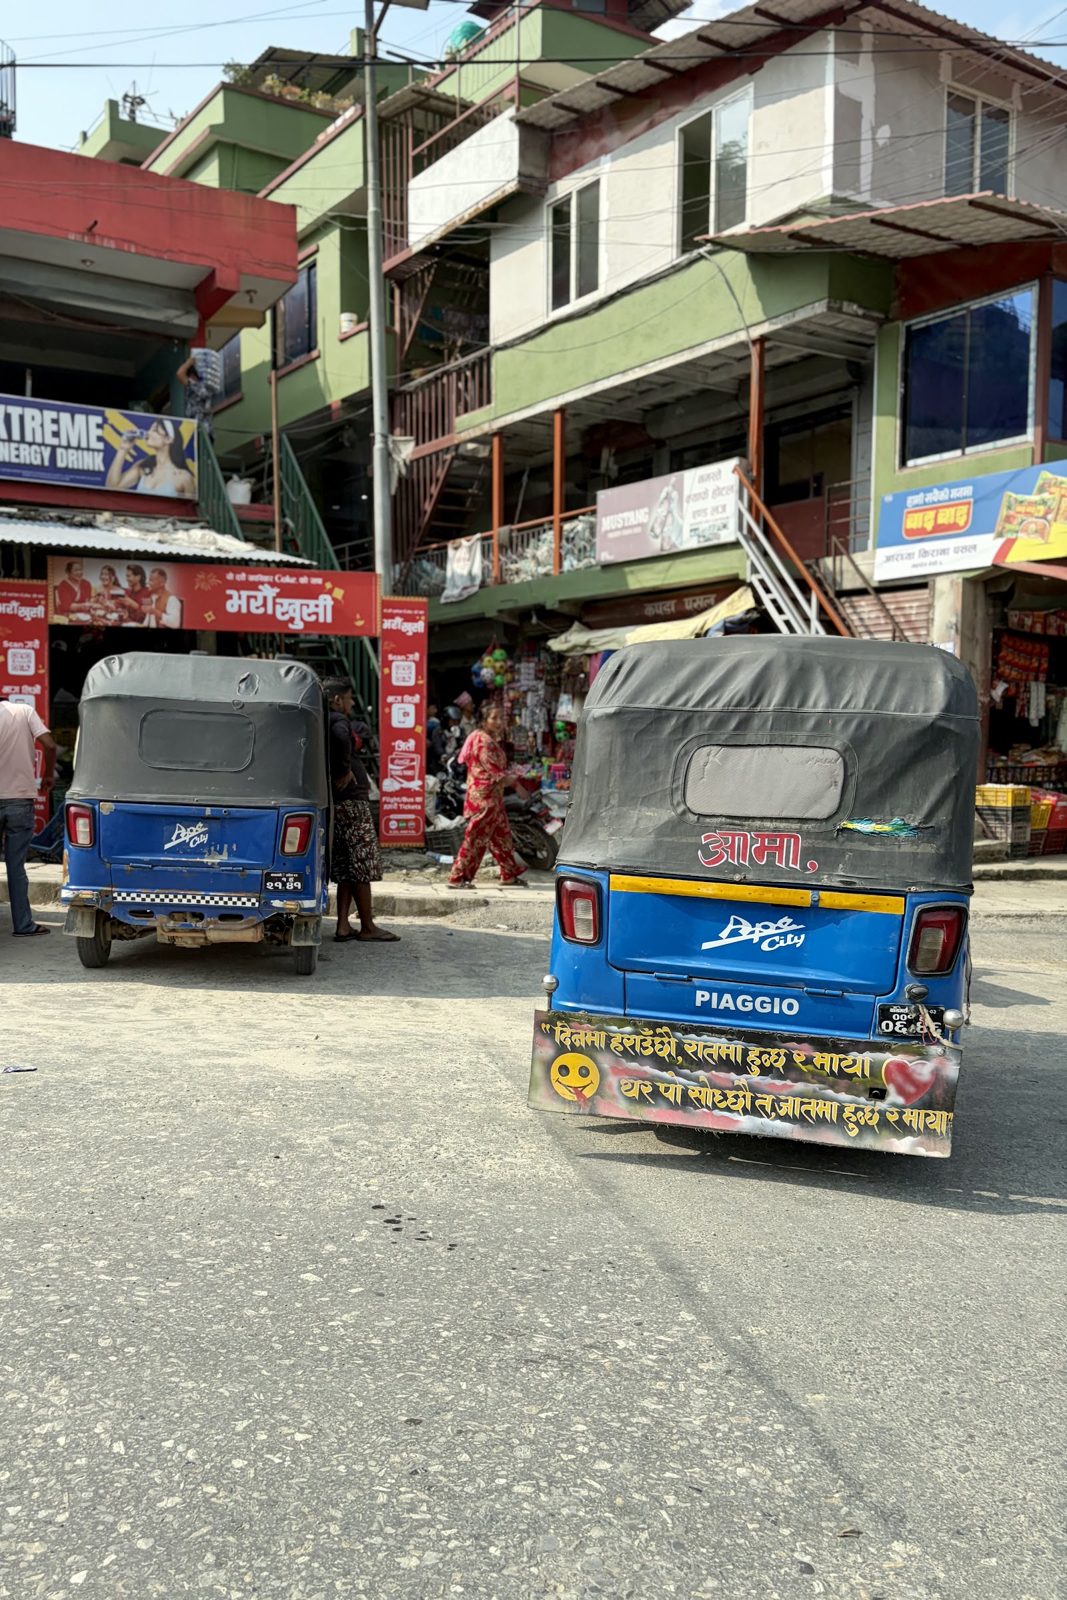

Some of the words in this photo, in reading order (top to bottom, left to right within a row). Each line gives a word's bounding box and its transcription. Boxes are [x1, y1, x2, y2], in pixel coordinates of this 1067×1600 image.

[56, 447, 105, 472] DRINK
[601, 507, 649, 533] MUSTANG
[953, 544, 978, 554] पसल
[275, 594, 334, 630] खुसी
[684, 593, 718, 610] पसल
[2, 640, 24, 648] Scan
[710, 914, 806, 947] Ape
[760, 933, 806, 952] City
[695, 990, 800, 1016] PIAGGIO
[682, 1038, 745, 1066] रातमा
[790, 1049, 808, 1073] र
[812, 1051, 874, 1079] माया
[620, 1078, 655, 1104] थर
[774, 1095, 841, 1125] जातमा
[885, 1107, 903, 1133] र
